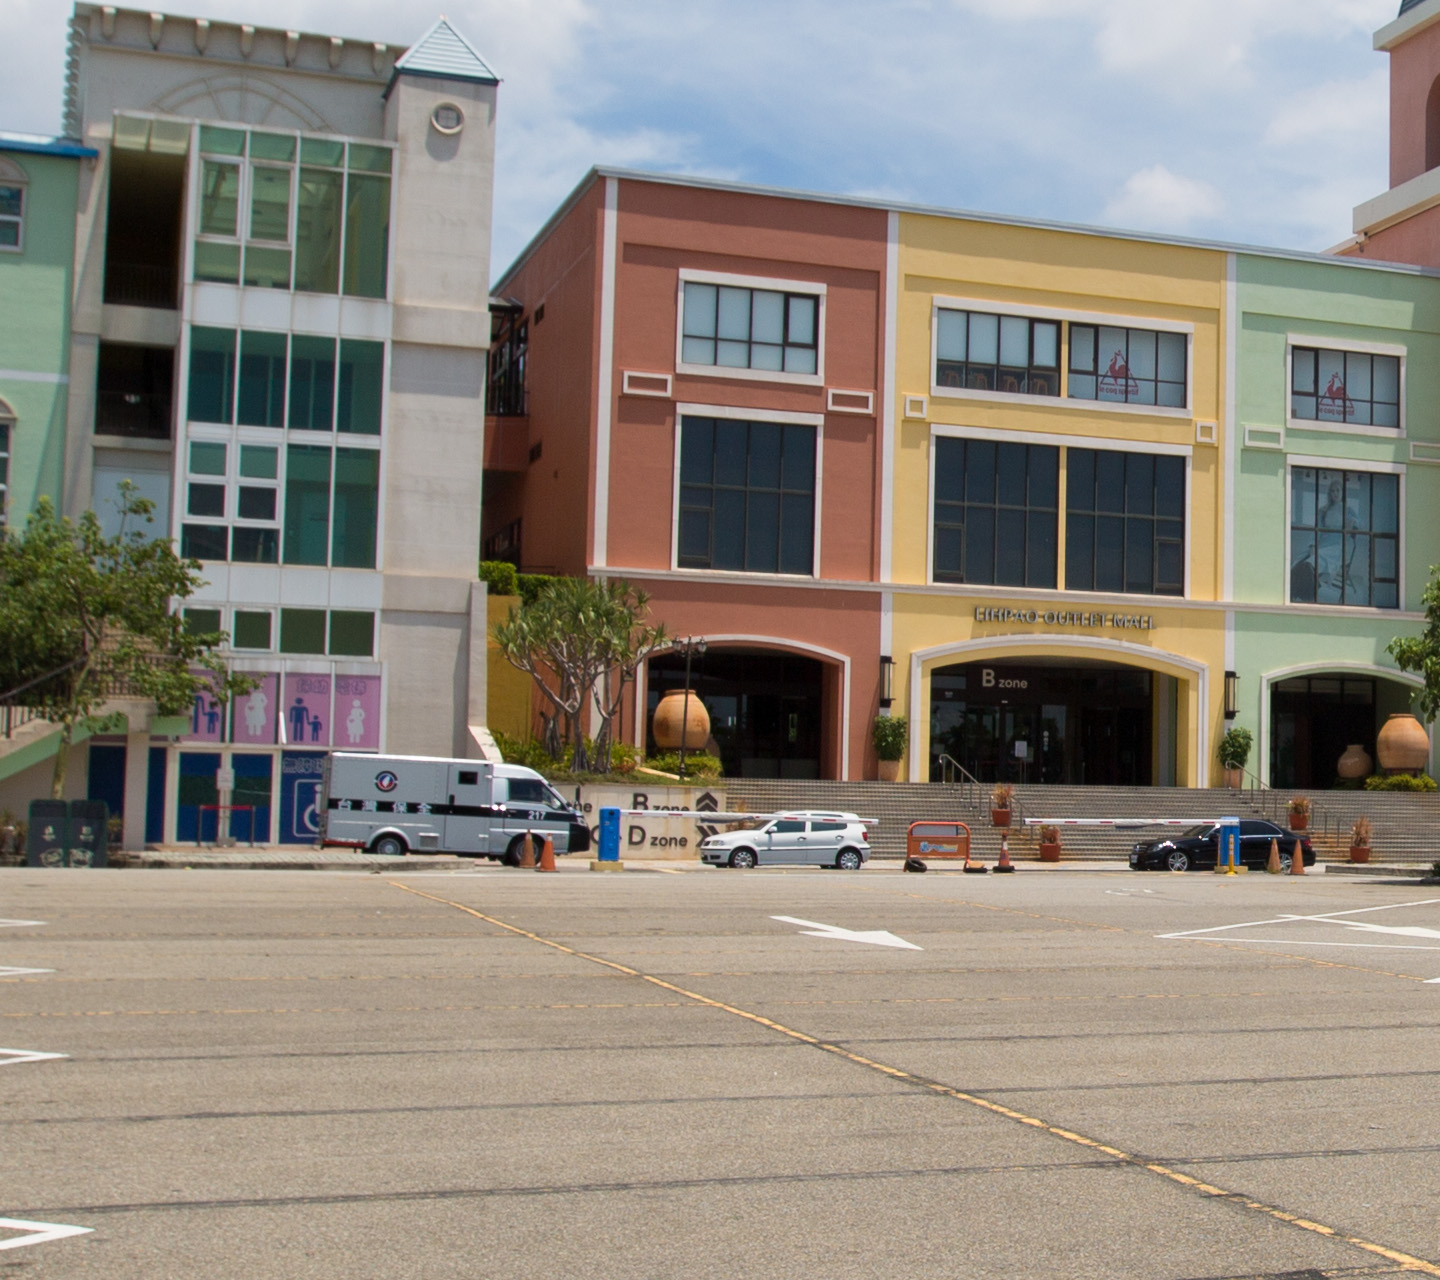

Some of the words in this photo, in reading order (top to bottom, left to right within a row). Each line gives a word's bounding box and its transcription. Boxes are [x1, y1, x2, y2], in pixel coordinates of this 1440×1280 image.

[975, 607, 1038, 624] LIHPAO
[1044, 610, 1106, 627] OUTLET
[1113, 614, 1154, 630] MALL
[982, 669, 995, 687] B
[998, 678, 1028, 689] zone
[338, 798, 432, 815] 台灣保全
[632, 793, 648, 811] B
[653, 803, 690, 812] zone
[528, 810, 546, 820] 217
[629, 825, 646, 845] D
[650, 836, 688, 847] zone
